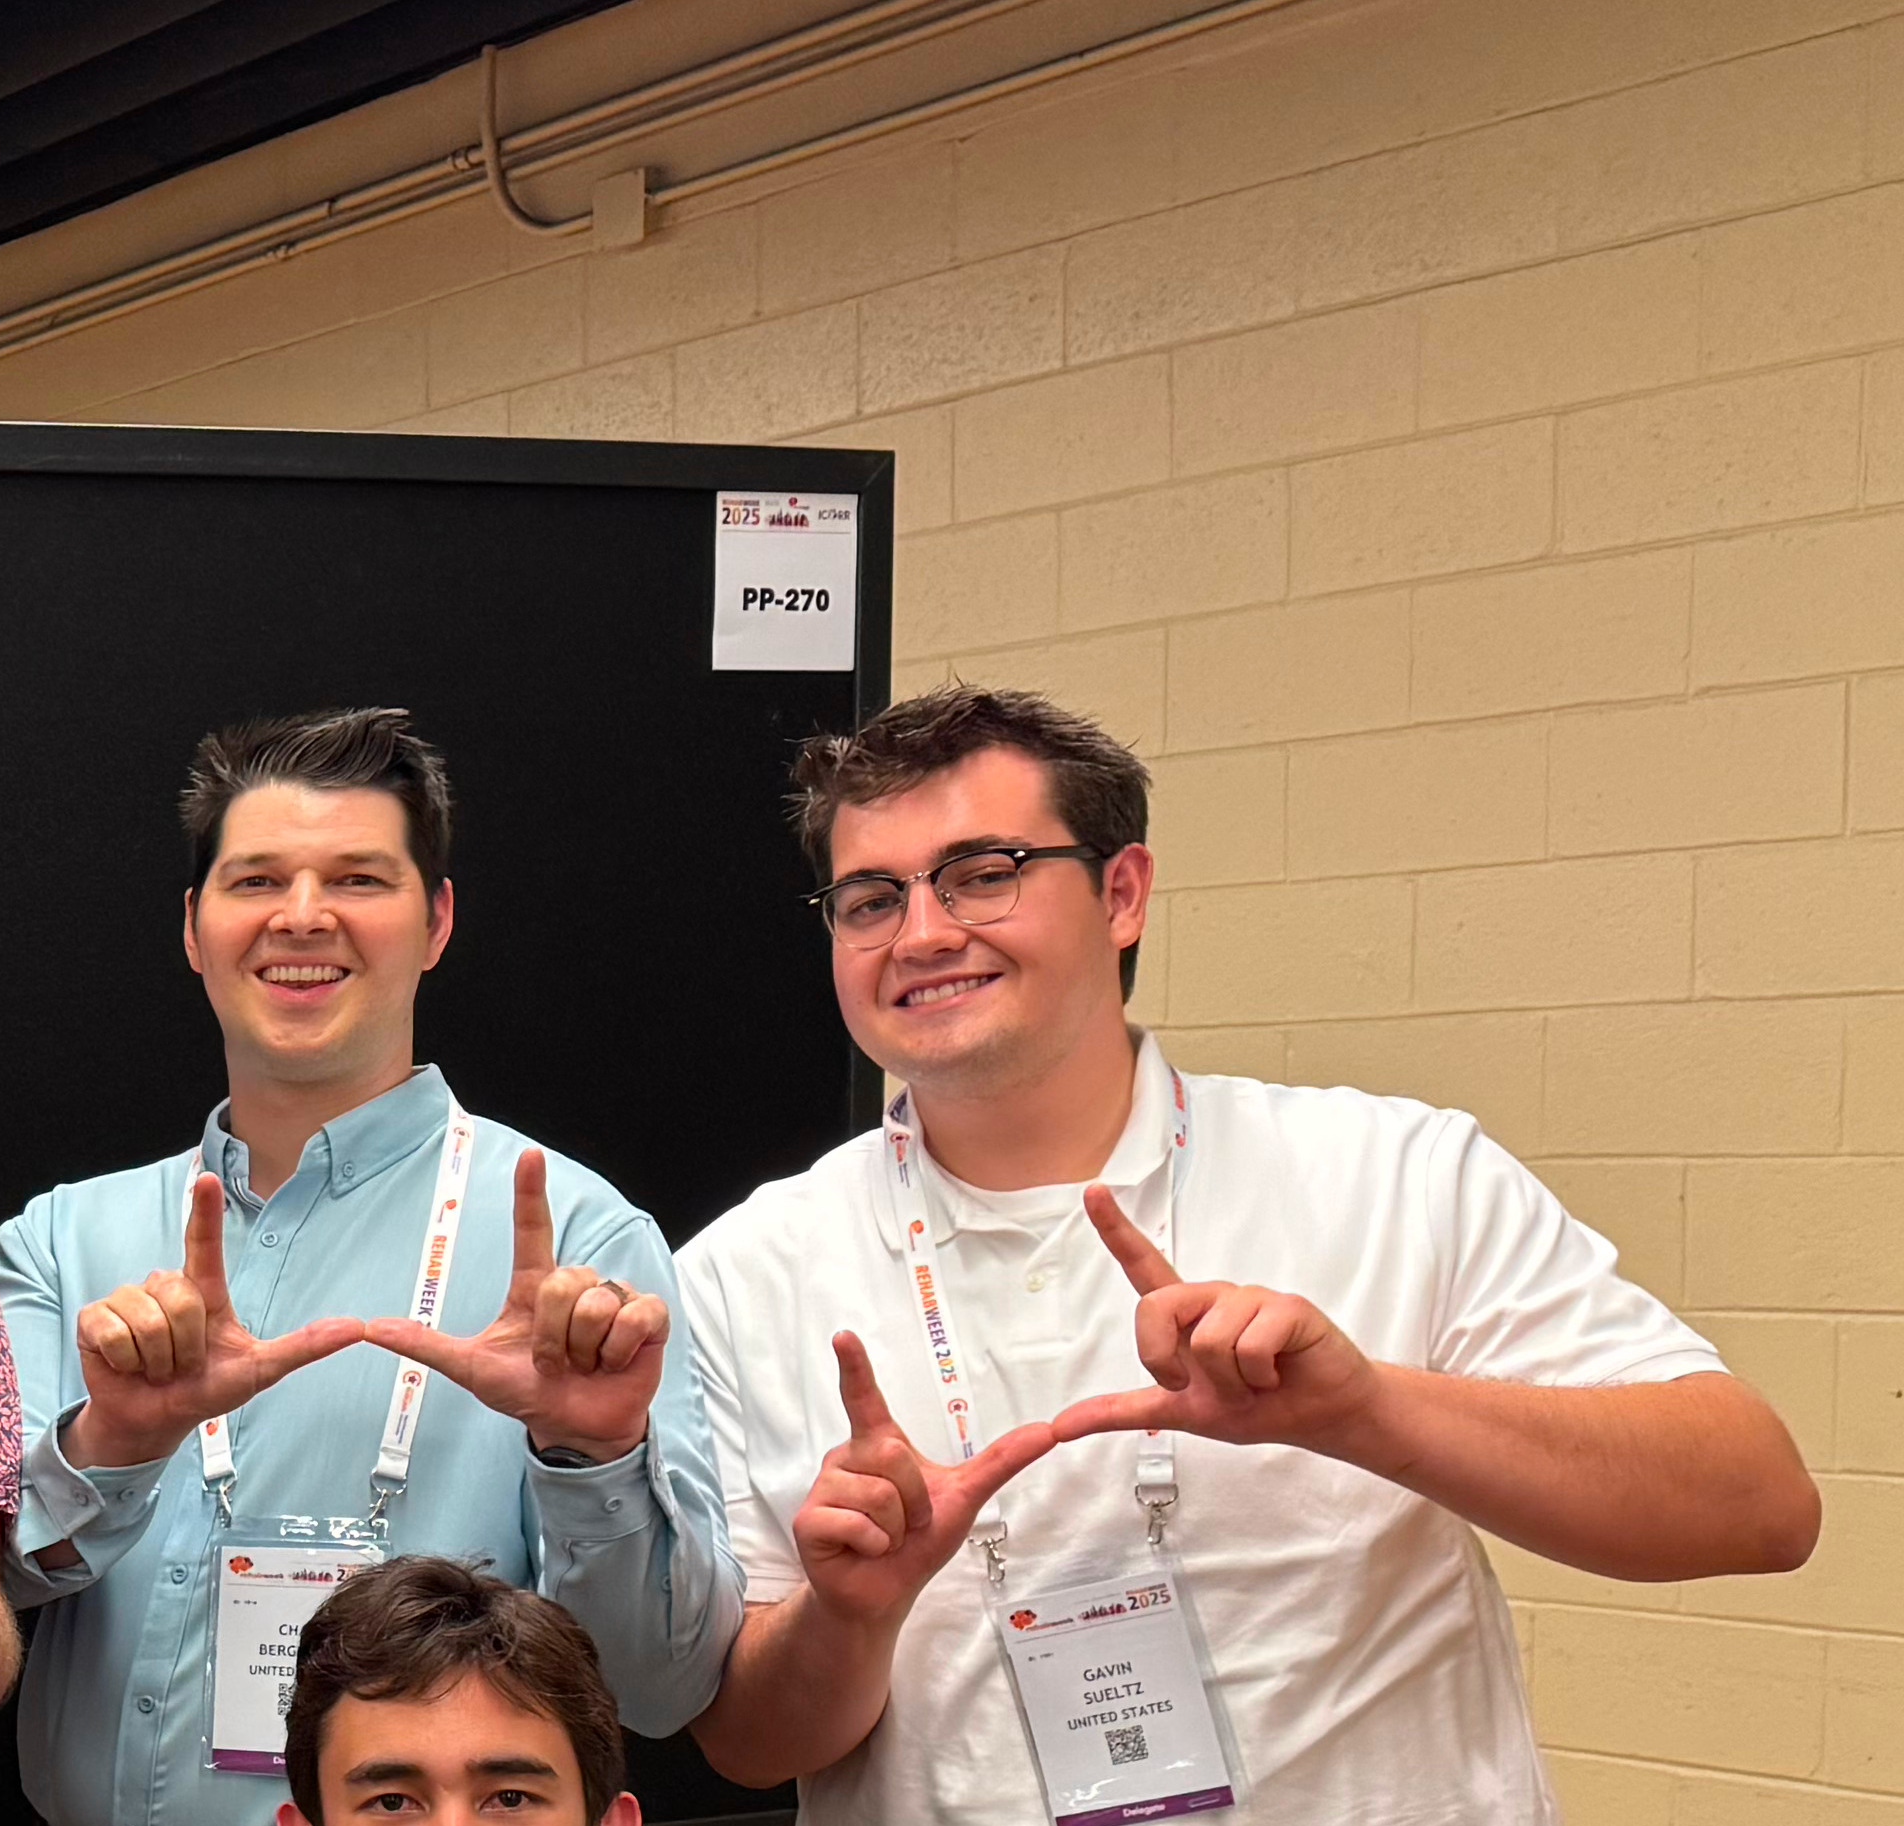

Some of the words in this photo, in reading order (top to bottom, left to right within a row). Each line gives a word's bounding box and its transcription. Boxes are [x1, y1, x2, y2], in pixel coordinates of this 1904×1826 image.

[722, 507, 761, 526] 2025
[742, 587, 831, 612] PP-270
[418, 1235, 447, 1317] REHABWEEK
[915, 1265, 947, 1347] REHABWEEK
[935, 1349, 958, 1384] 2025
[1127, 1590, 1172, 1611] 2025
[259, 1644, 299, 1657] BERG
[249, 1665, 294, 1677] UNITED
[1083, 1661, 1132, 1682] GAVIN
[1083, 1682, 1144, 1705] SUELTZ
[1067, 1711, 1117, 1730] UNITED
[1121, 1699, 1173, 1720] STATES
